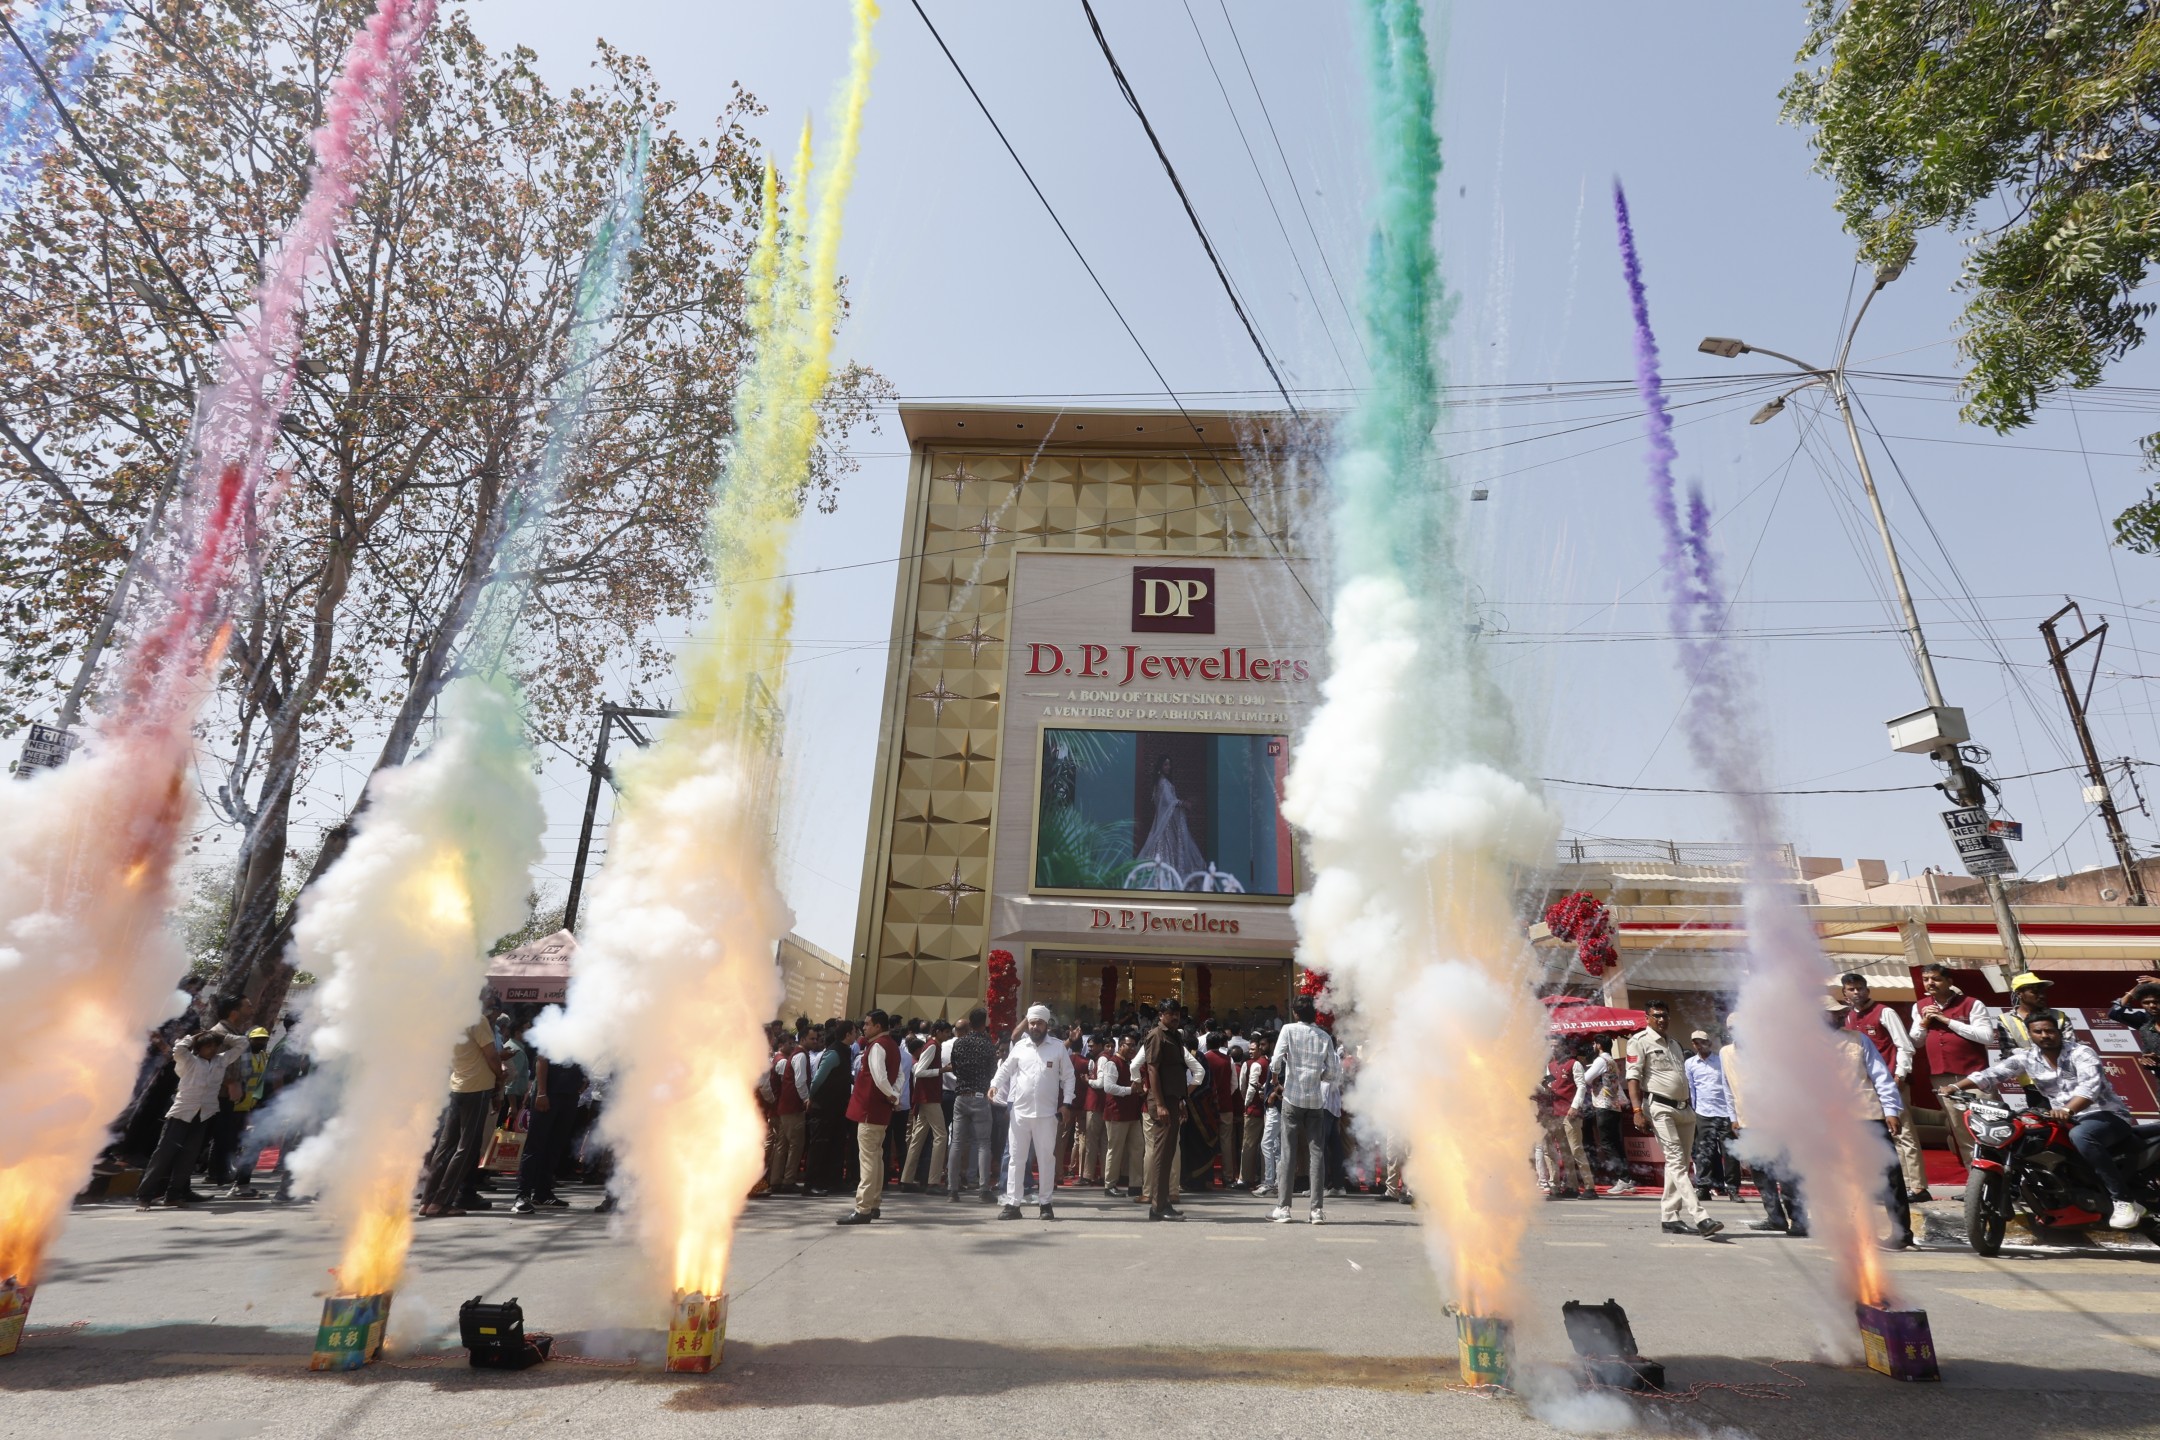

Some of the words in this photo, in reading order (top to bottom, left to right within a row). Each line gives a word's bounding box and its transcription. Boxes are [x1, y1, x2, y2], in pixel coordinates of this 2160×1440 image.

[1139, 578, 1208, 618] DP
[1025, 642, 1109, 678] D.P.
[1118, 645, 1311, 686] Jewellers
[1067, 690, 1077, 701] A
[1080, 690, 1119, 702] BOND
[1122, 691, 1142, 703] OF
[1144, 692, 1191, 704] TRUST
[1192, 693, 1235, 705] SINCE
[1238, 694, 1266, 706] 1940
[1043, 706, 1052, 717] A
[1054, 707, 1114, 718] VENTURE
[1117, 708, 1134, 719] OF
[1136, 709, 1158, 720] D.P.
[1161, 710, 1231, 721] ABHUSHAN
[1234, 711, 1289, 723] LIMITED
[29, 740, 55, 753] NEET,
[1268, 744, 1280, 754] DP
[26, 750, 50, 760] NEET
[26, 757, 47, 765] 2024
[1952, 825, 1982, 837] NEET,
[1957, 837, 1983, 847] NEET
[1090, 909, 1135, 930] D.P.
[1140, 911, 1240, 935] Jewellers
[530, 954, 569, 962] Jewelle
[508, 990, 537, 998] ON-AIR
[1563, 1022, 1580, 1030] D.P.
[1580, 1019, 1635, 1029] JEWELLERS
